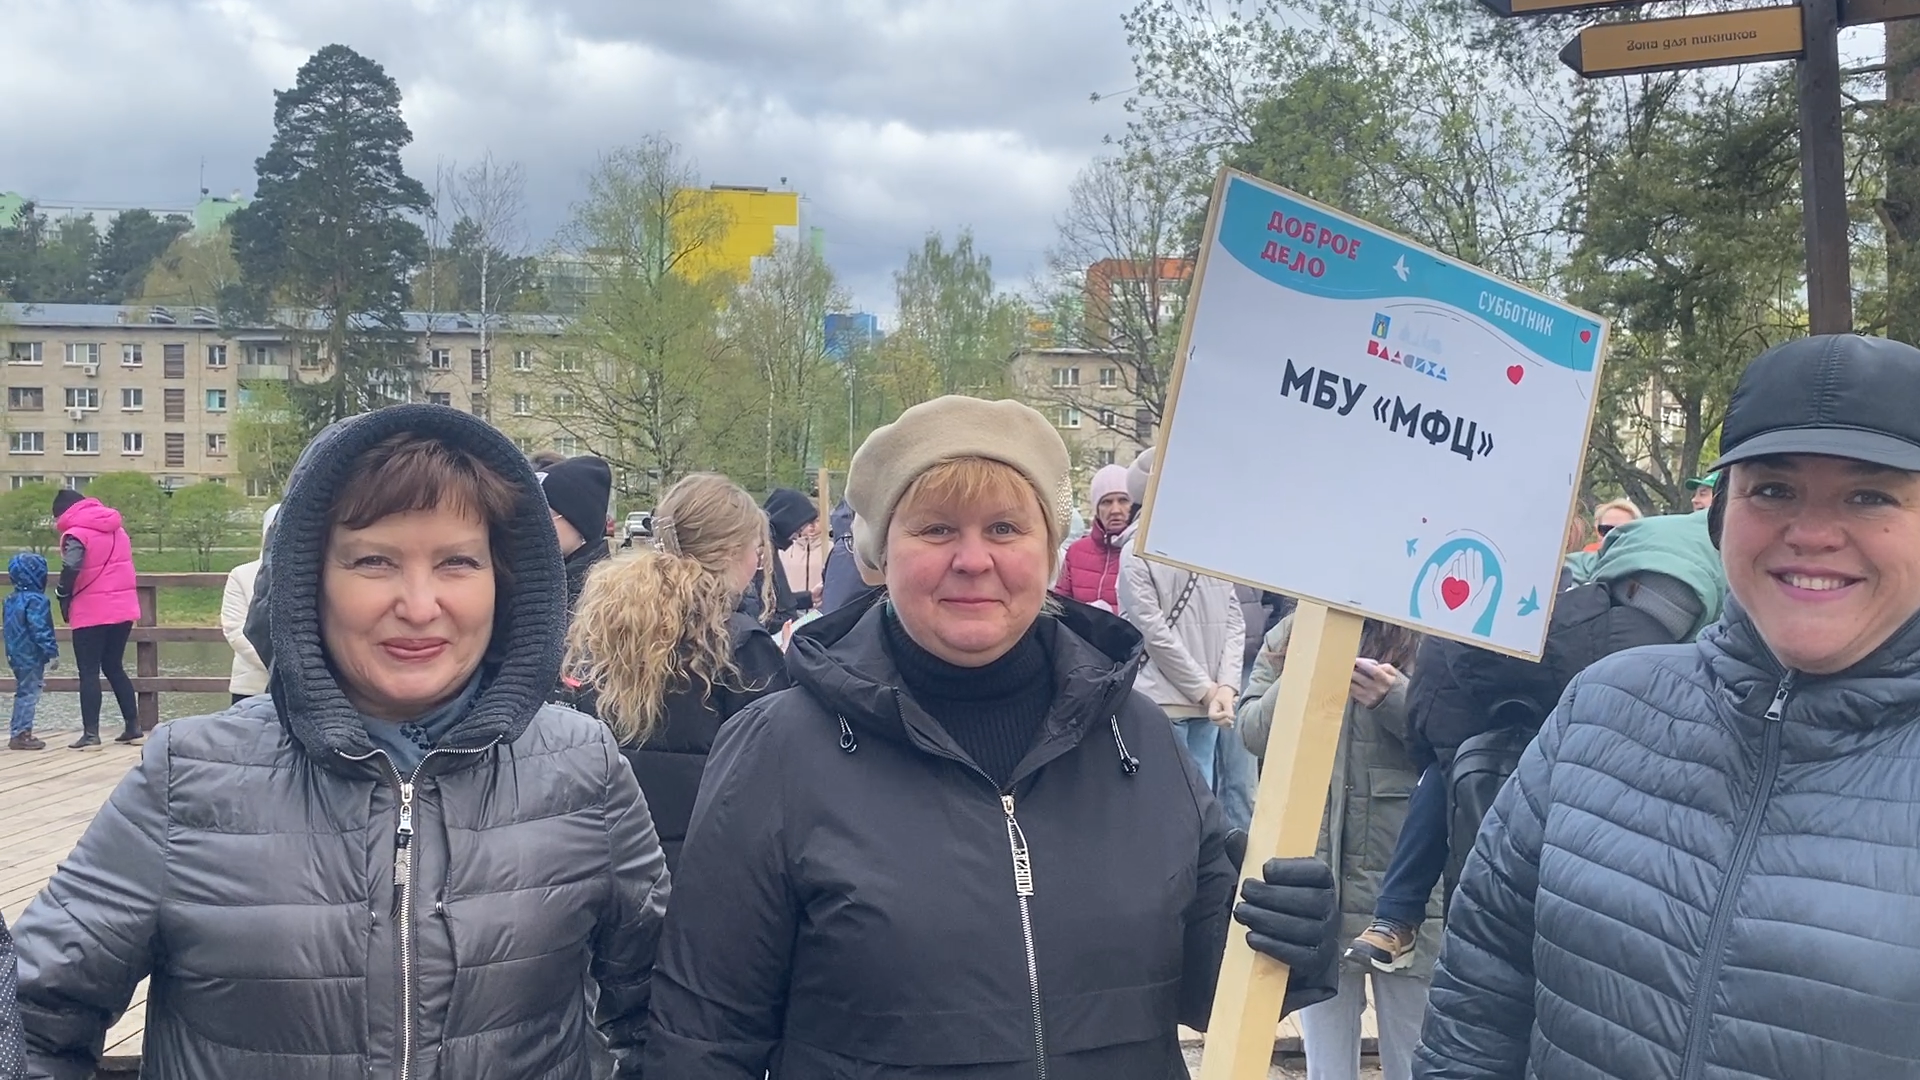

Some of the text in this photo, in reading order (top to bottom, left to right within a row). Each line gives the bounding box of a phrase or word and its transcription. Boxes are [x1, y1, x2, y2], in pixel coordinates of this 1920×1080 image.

[1626, 29, 1758, 52] Зона для пикников
[1267, 211, 1361, 260] ДОБРОЕ
[1260, 240, 1325, 278] ДЕЛО
[1478, 291, 1554, 337] СУББОТНИК
[1280, 358, 1494, 462] МБУ «МФЦ»
